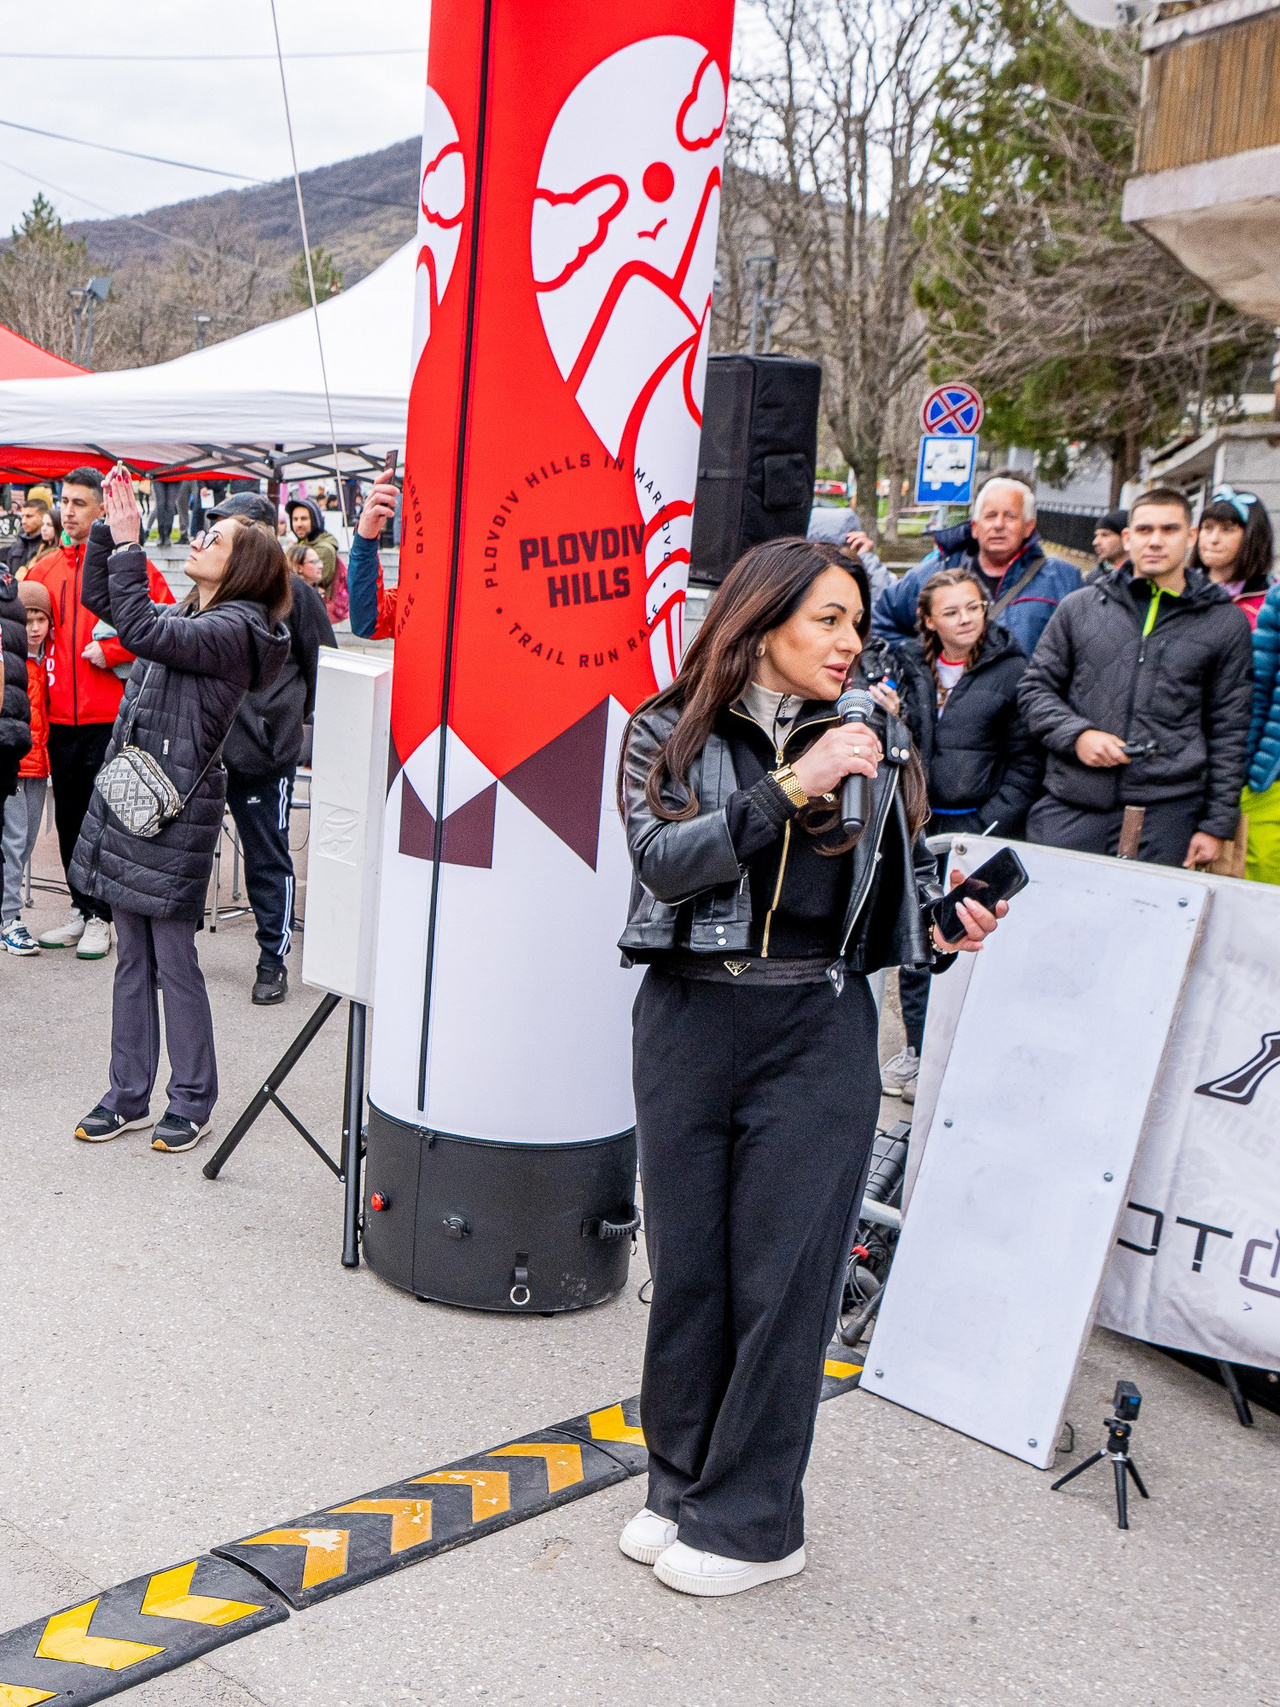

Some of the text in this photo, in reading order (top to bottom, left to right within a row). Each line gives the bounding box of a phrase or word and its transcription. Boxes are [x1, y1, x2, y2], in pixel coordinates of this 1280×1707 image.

[484, 491, 519, 588] PLOVDIV
[525, 453, 591, 488] HILLS
[604, 455, 625, 471] IN
[634, 467, 672, 562] MARKOVO
[520, 523, 645, 571] PLOVDIV
[547, 566, 630, 608] HILLS
[508, 604, 661, 668] TRAIL RUN RACE
